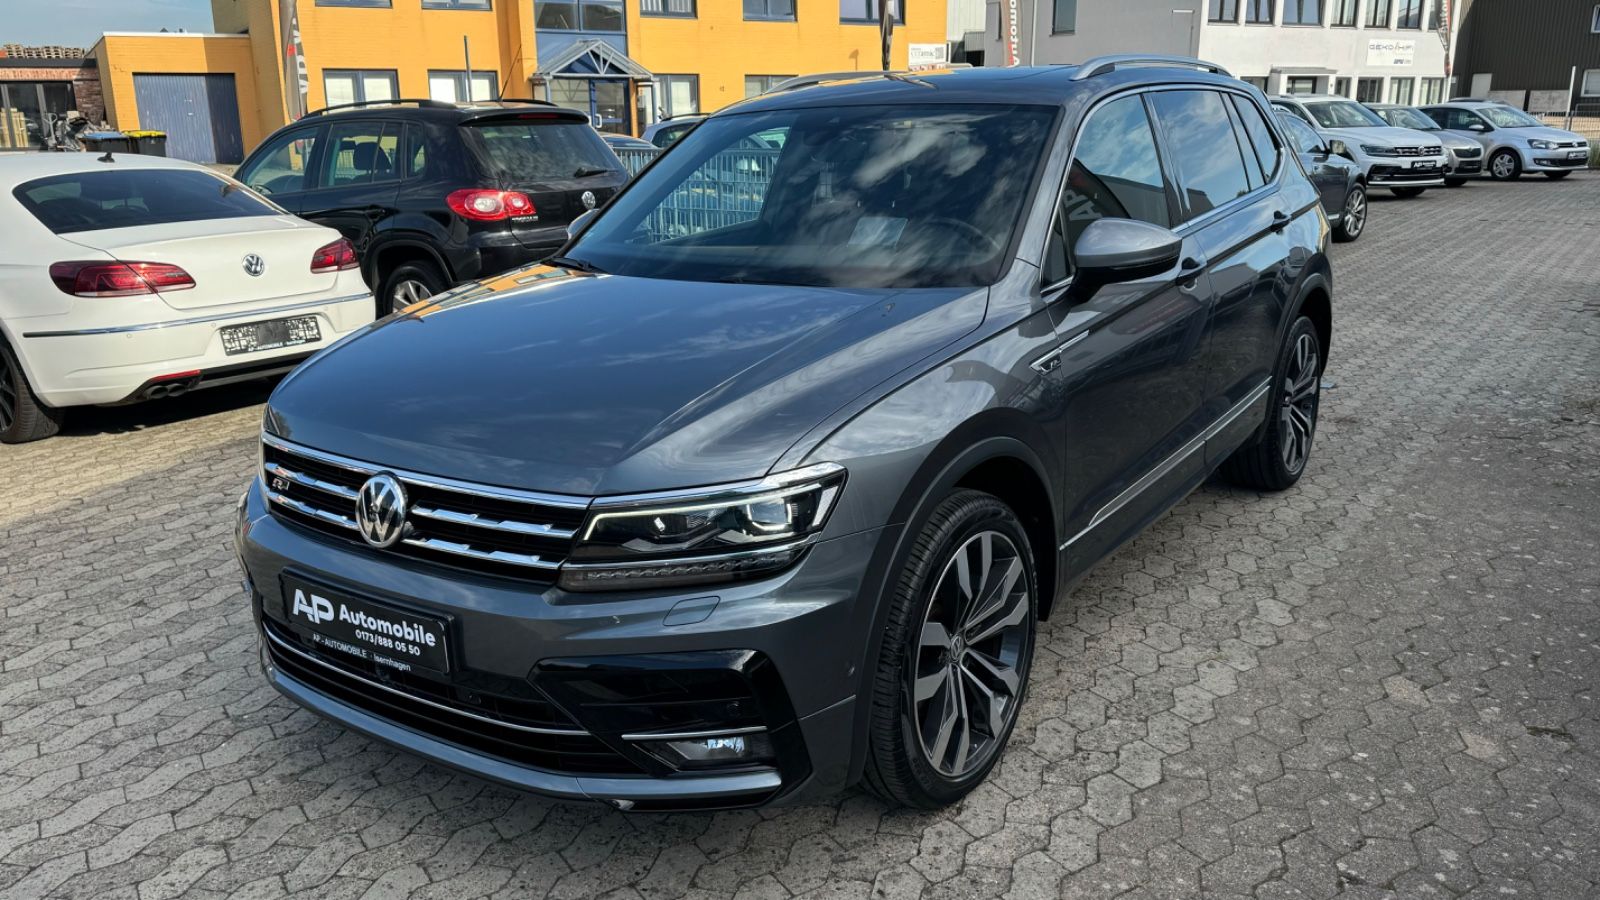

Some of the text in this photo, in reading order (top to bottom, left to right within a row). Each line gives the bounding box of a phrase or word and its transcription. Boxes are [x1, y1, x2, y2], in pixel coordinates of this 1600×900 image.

[293, 588, 436, 647] AP Automobile
[355, 629, 421, 656] 0173/888 05 50
